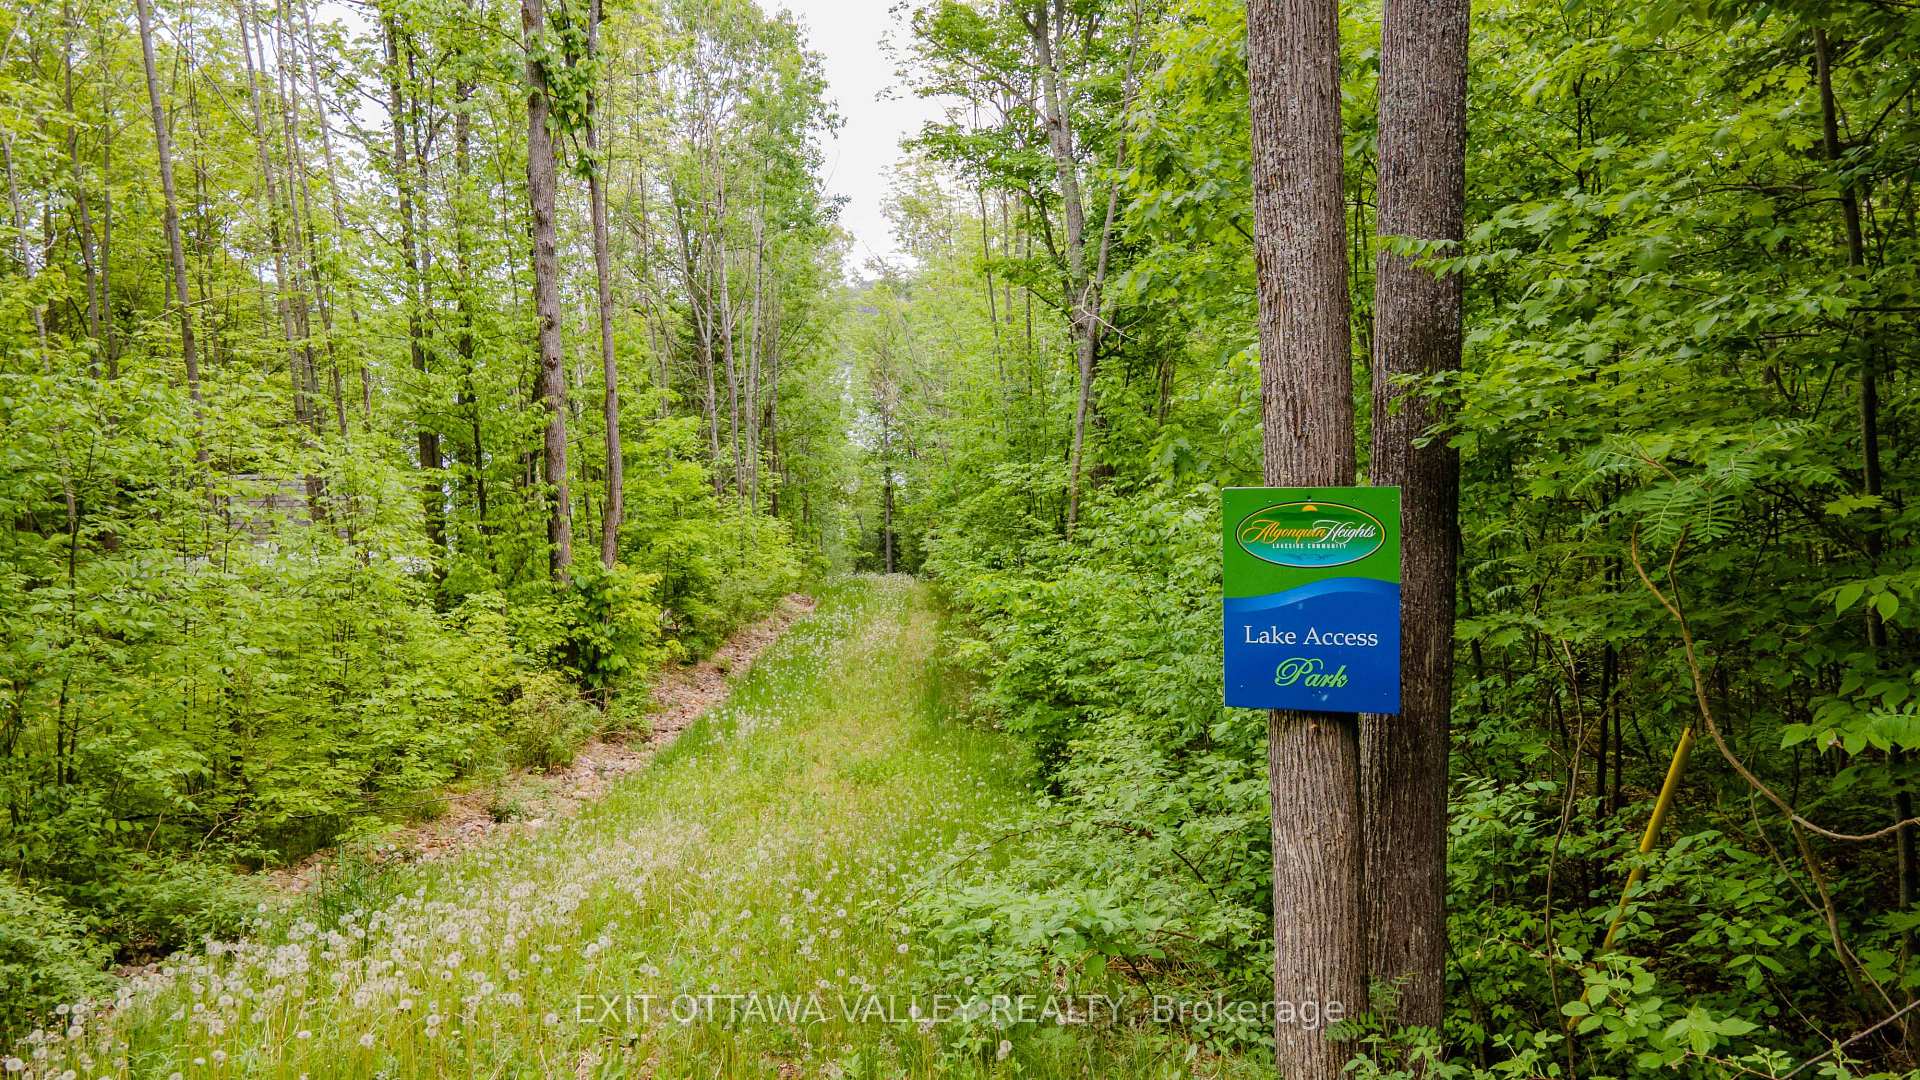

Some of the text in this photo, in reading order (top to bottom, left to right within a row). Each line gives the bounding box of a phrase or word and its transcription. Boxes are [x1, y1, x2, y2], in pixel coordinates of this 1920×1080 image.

[1242, 519, 1377, 544] Algonquin Heights
[1243, 625, 1378, 647] Lake Access
[1274, 657, 1349, 688] Park
